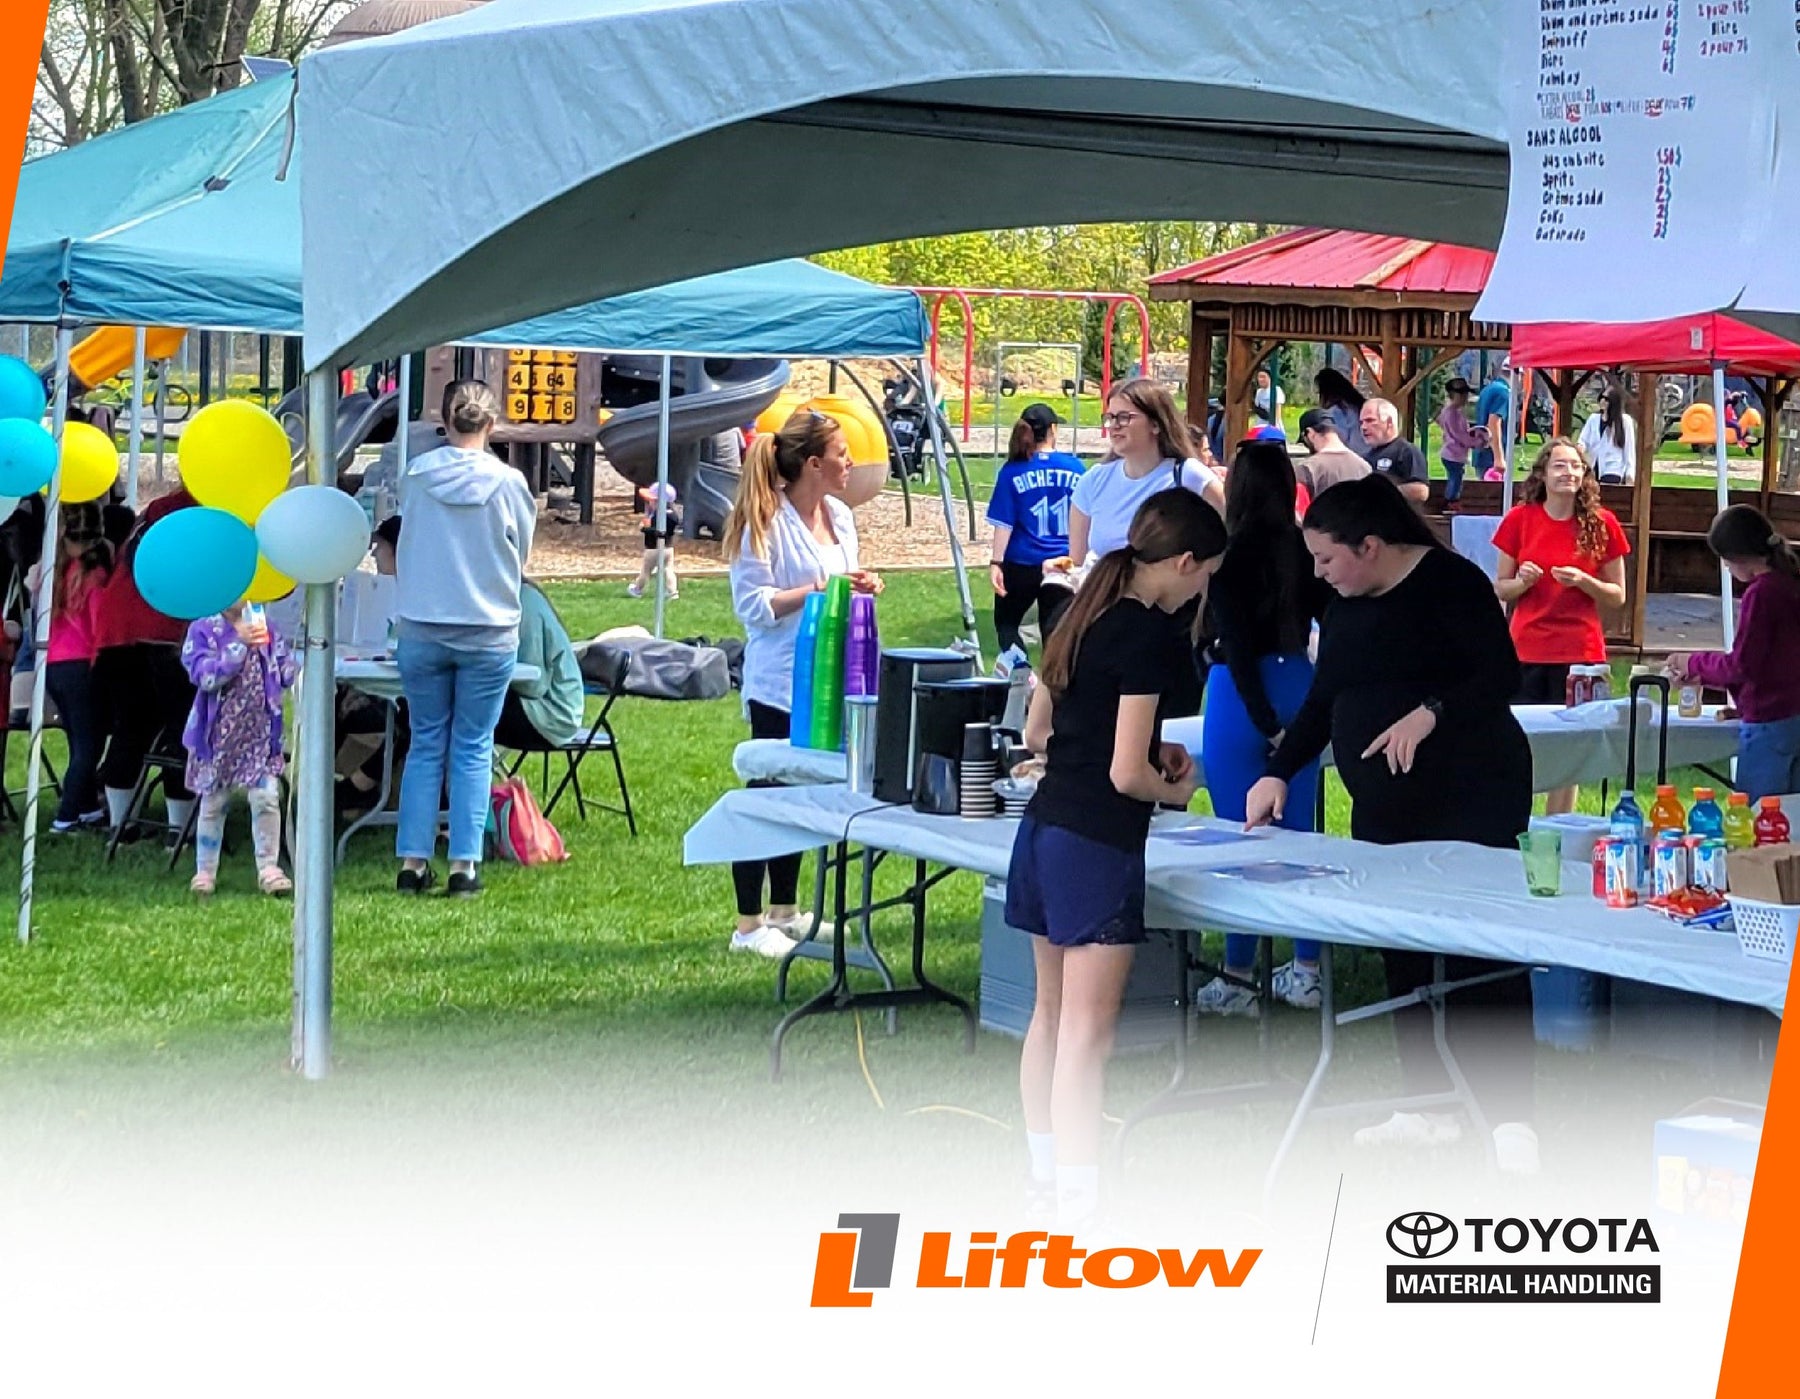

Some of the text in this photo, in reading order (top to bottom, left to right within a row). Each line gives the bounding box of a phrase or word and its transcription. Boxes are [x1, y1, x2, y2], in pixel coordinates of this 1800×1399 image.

[1568, 11, 1586, 27] and
[1629, 4, 1658, 23] soda
[1706, 4, 1728, 20] pour
[1709, 41, 1734, 56] pour
[1527, 125, 1602, 147] SANS ALCOOL
[1542, 170, 1574, 190] Sprite
[1577, 188, 1603, 205] soda
[512, 371, 523, 386] 4
[514, 398, 525, 415] 9
[545, 400, 553, 415] 7
[563, 401, 573, 416] 8
[1029, 495, 1068, 536] 11
